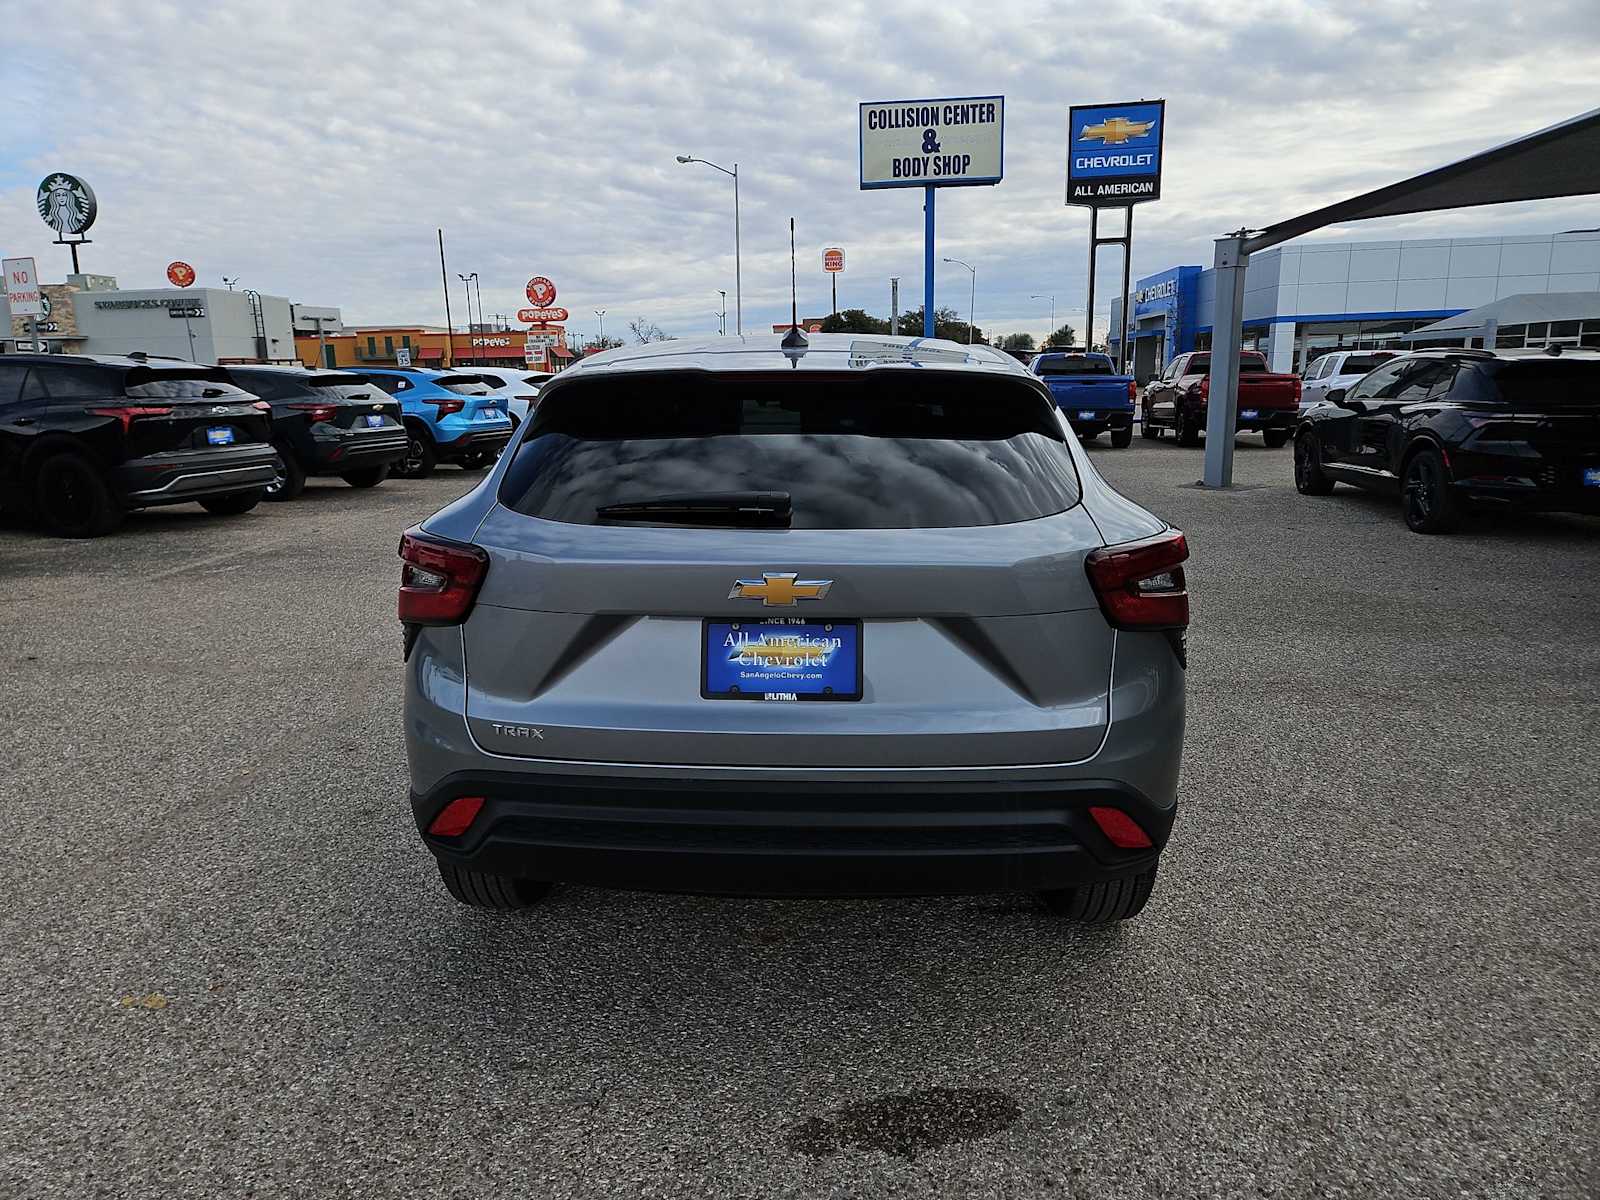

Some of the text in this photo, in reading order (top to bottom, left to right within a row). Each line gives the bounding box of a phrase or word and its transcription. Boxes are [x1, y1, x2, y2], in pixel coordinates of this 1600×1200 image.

[868, 103, 995, 130] COLLISION CENTER
[921, 128, 941, 154] &
[892, 154, 971, 178] BODY SHOP
[1075, 153, 1154, 169] CHEVROLET
[1074, 182, 1154, 196] ALL AMERICAN
[12, 271, 29, 284] NO
[9, 291, 39, 303] PARKING
[723, 632, 842, 648] All American
[738, 652, 828, 667] Chevrolet
[740, 671, 823, 680] SanAngeloChevy.com
[772, 692, 798, 701] LITHIA
[491, 723, 544, 740] TRAX
